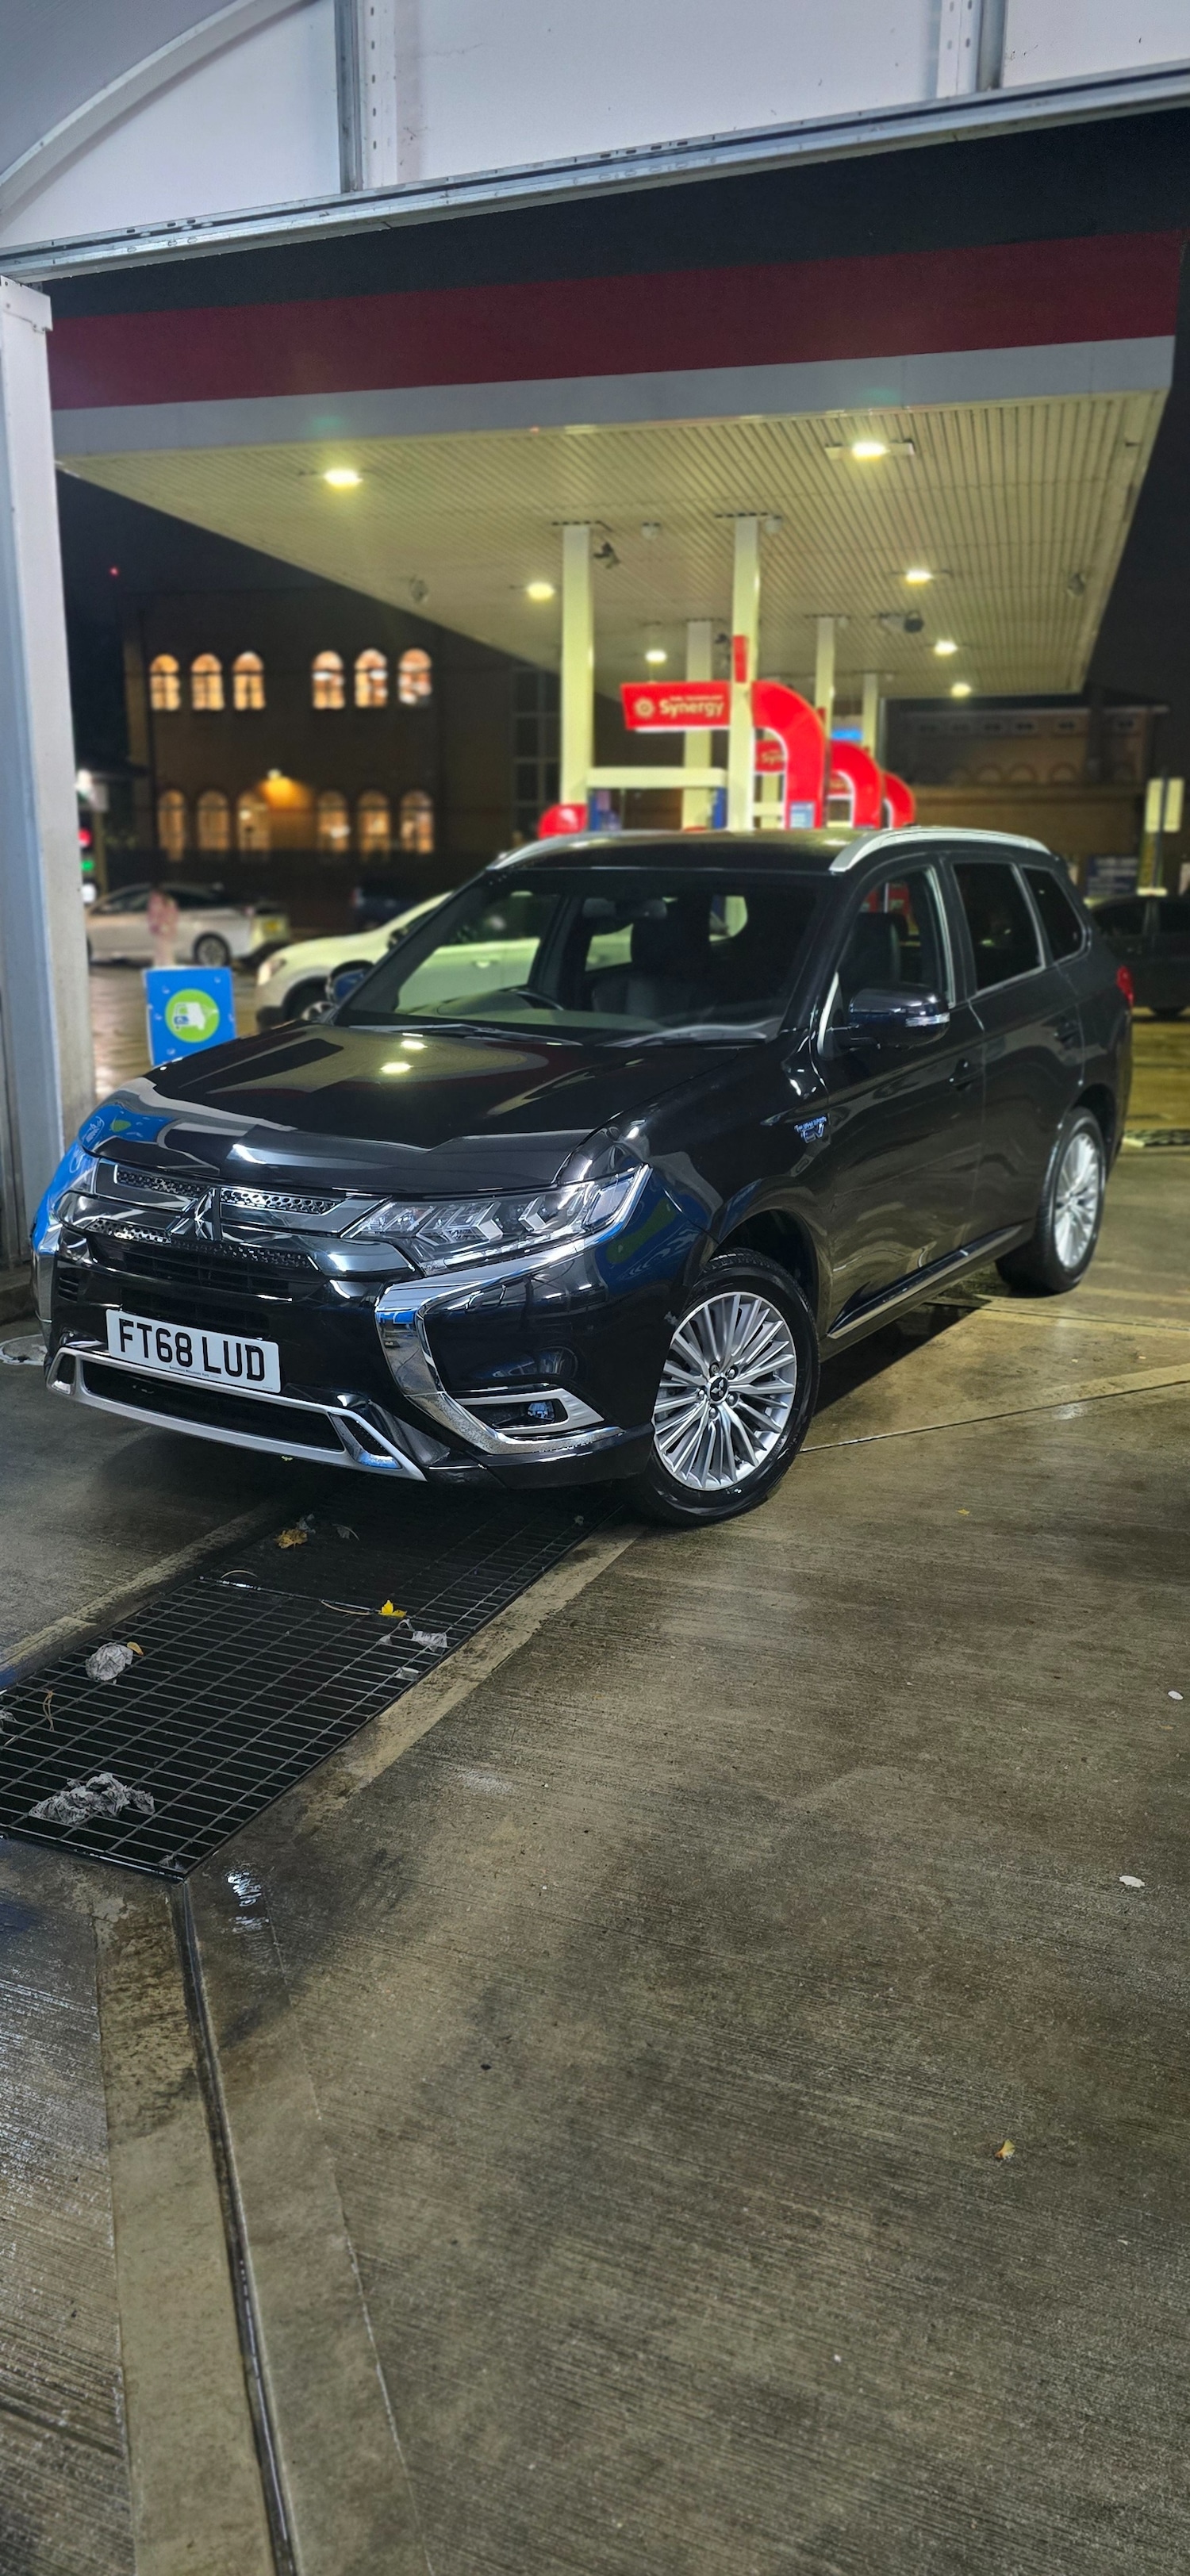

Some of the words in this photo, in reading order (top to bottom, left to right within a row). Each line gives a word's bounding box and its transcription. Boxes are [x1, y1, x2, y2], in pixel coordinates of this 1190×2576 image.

[659, 698, 724, 718] Synergy
[118, 1318, 193, 1367] FT68
[202, 1336, 265, 1381] LUD
